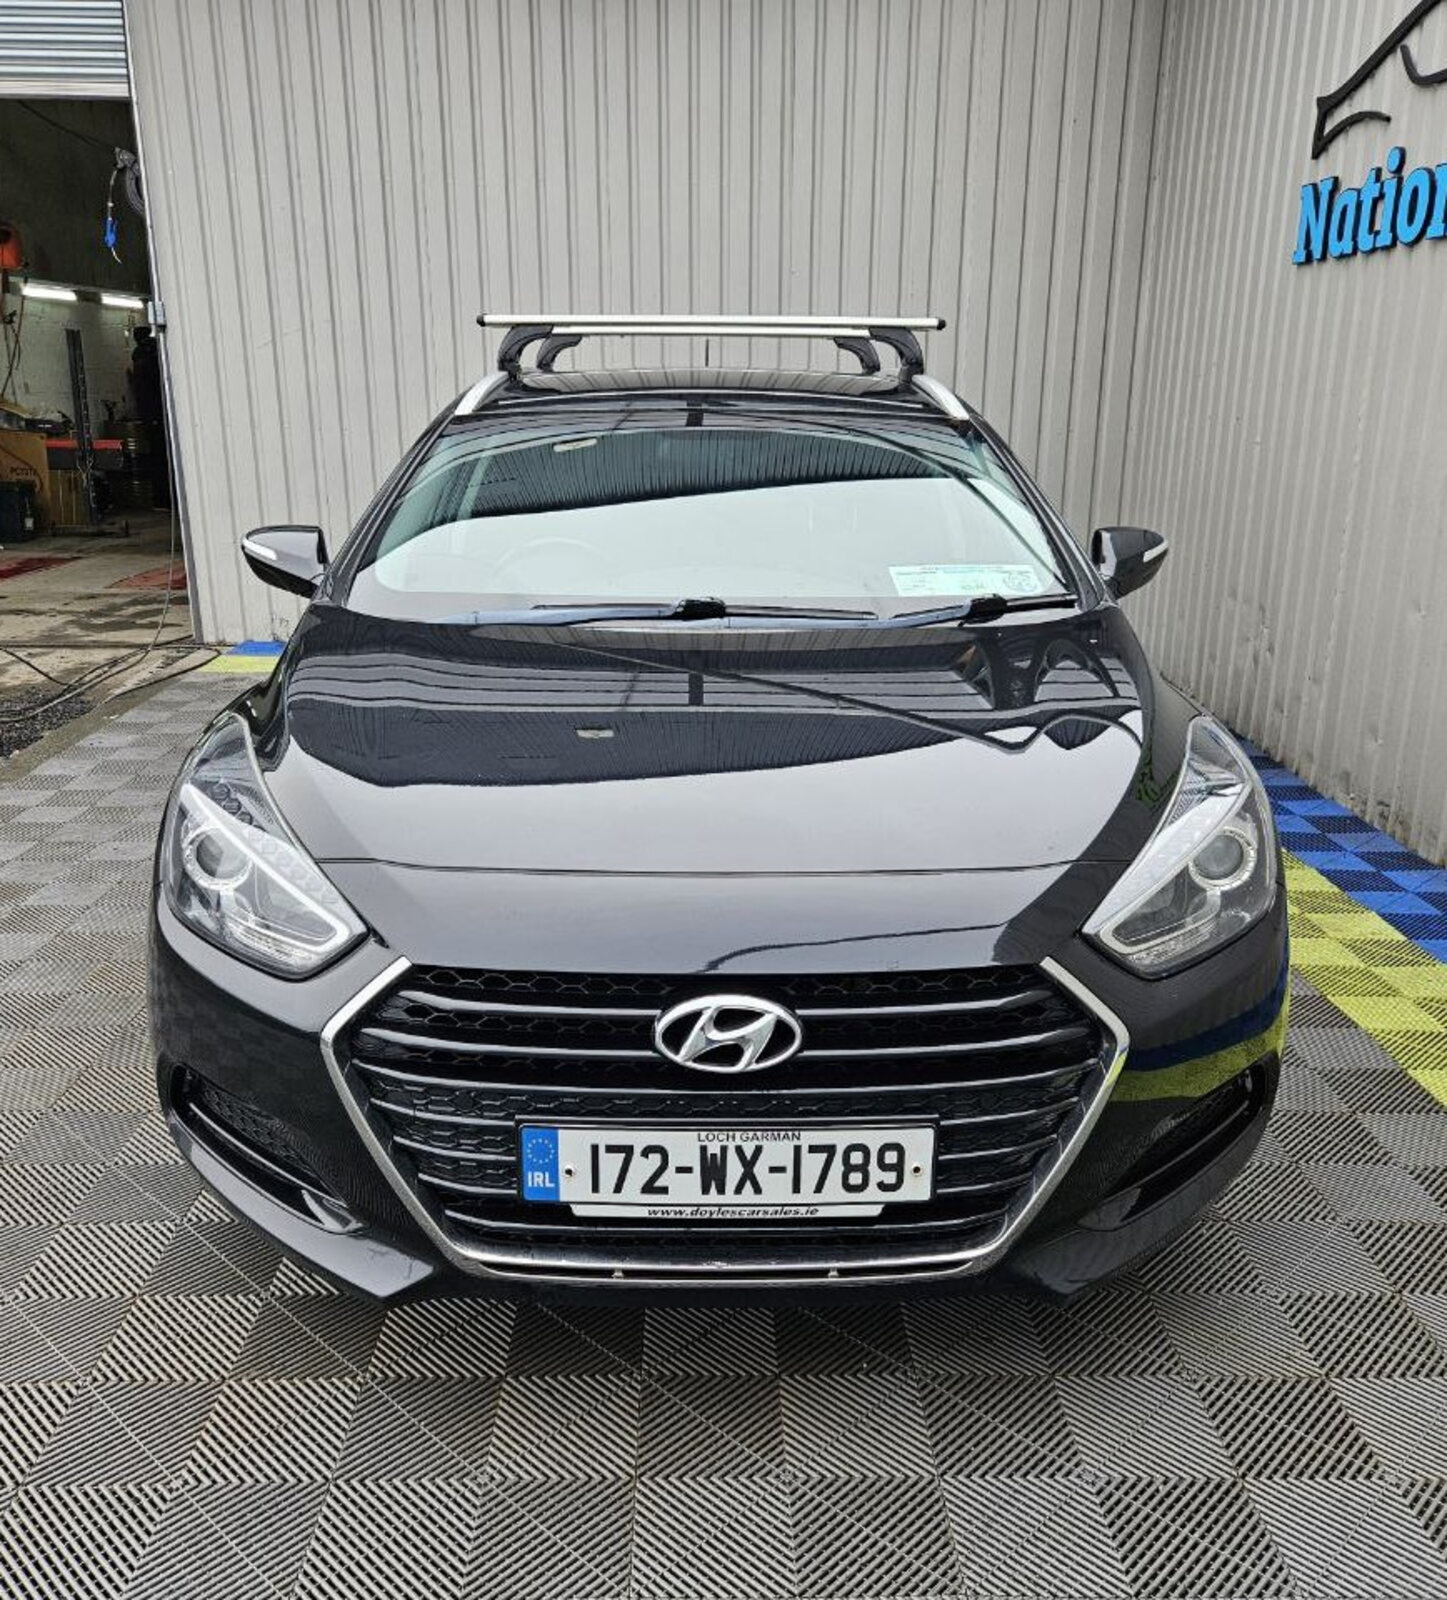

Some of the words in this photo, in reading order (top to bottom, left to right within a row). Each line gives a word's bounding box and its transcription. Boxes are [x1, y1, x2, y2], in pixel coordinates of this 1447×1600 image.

[698, 1132, 736, 1142] LOCH
[740, 1131, 801, 1142] GARMAN
[590, 1143, 906, 1196] 172-WX-1789
[527, 1171, 555, 1188] IRL
[647, 1206, 820, 1219] www.doylescarsales.ie
